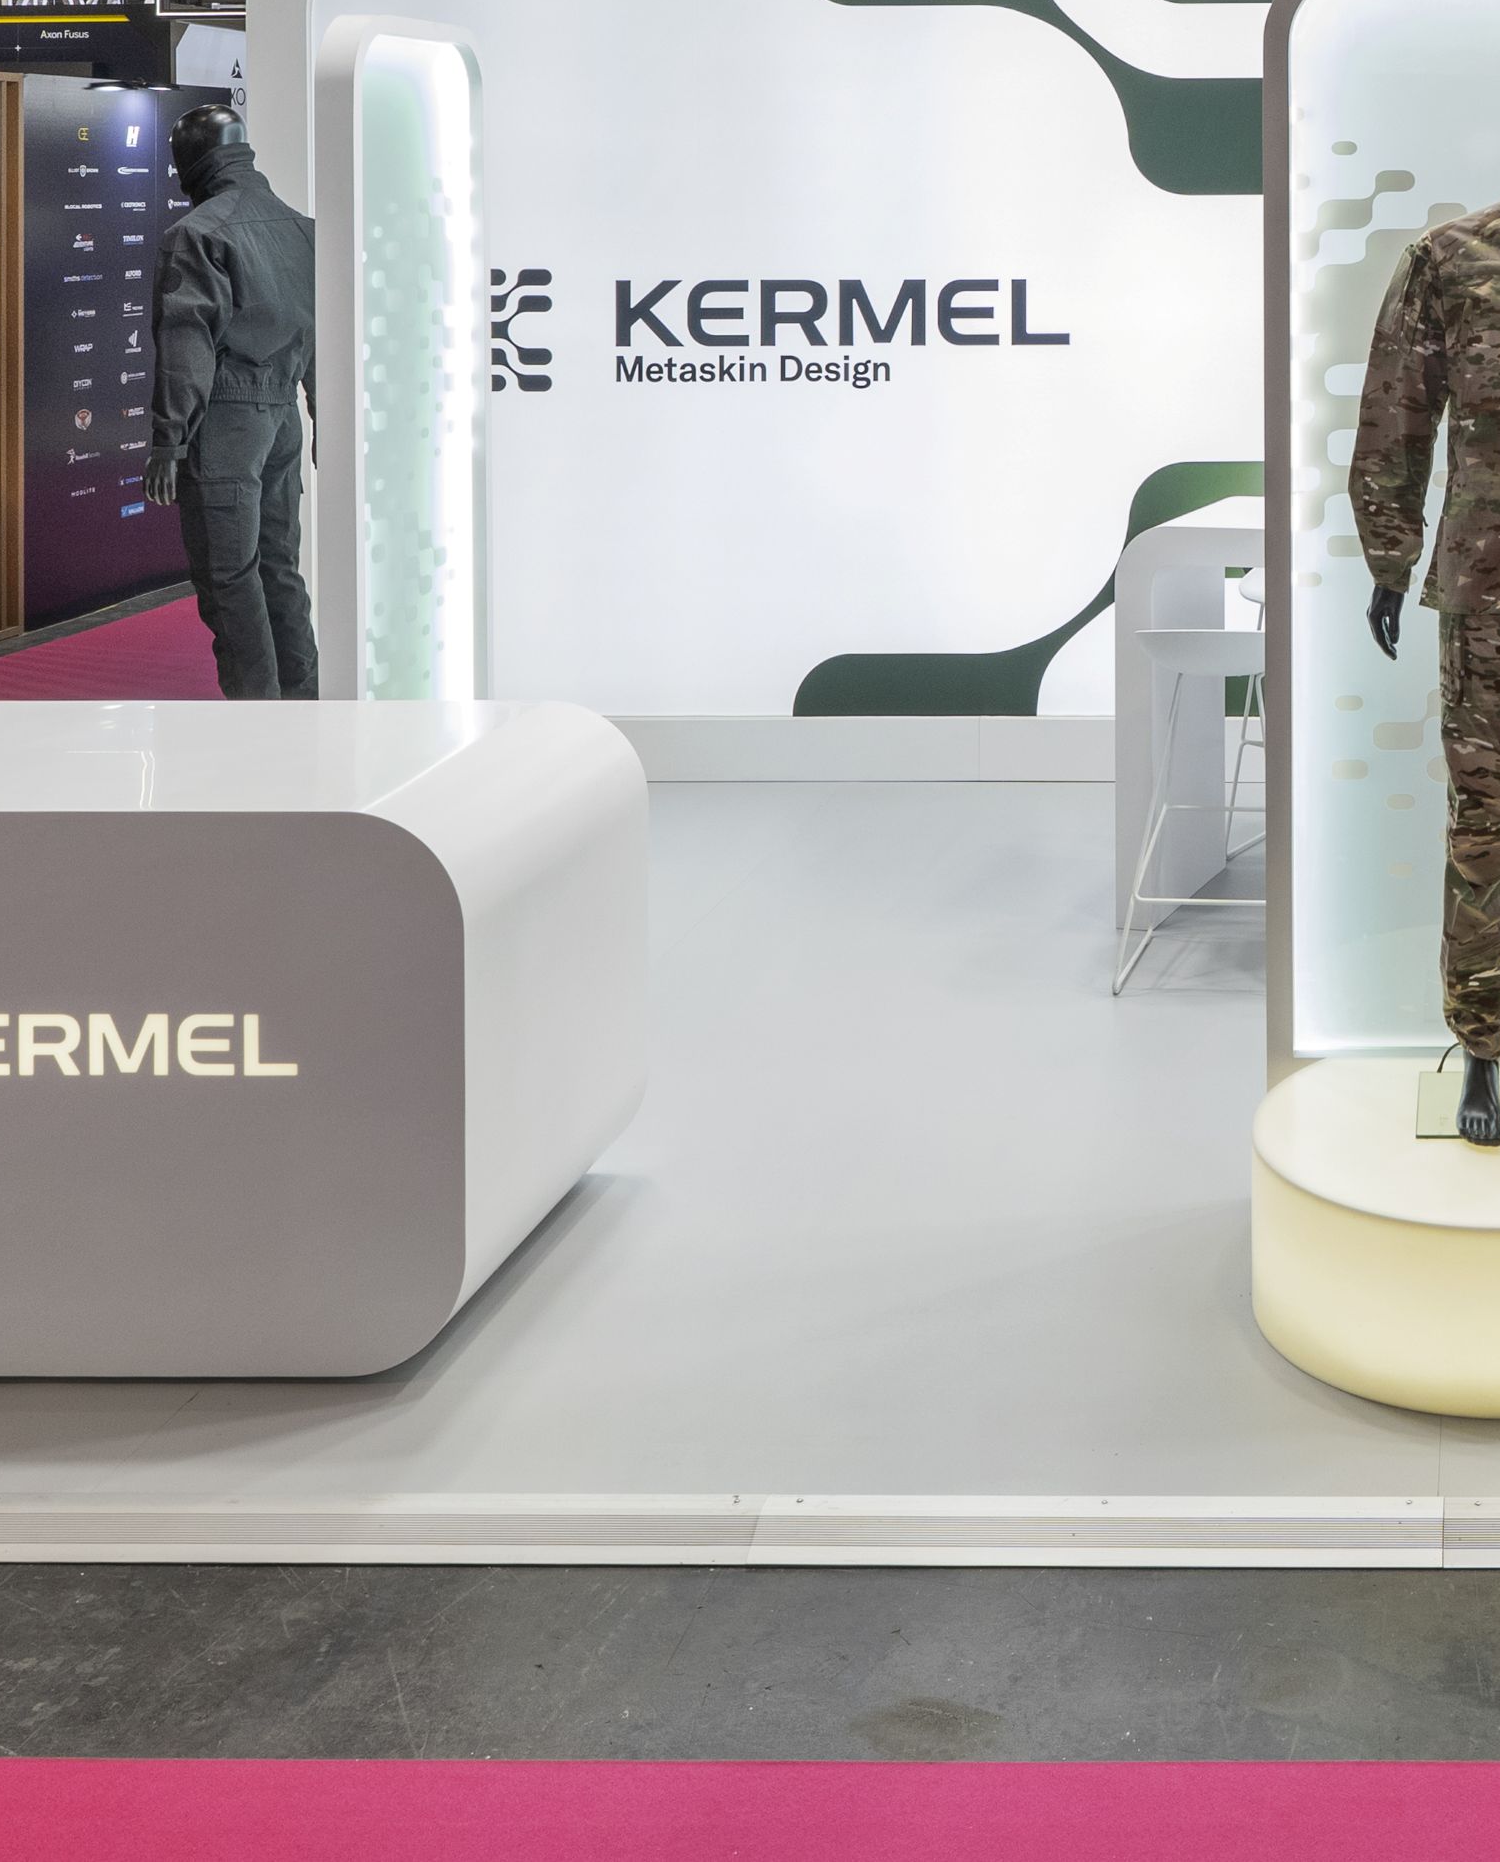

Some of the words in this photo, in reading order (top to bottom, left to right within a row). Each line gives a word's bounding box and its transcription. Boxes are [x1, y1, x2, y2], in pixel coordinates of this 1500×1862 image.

[40, 30, 62, 39] Axon
[64, 29, 90, 39] Fusus
[615, 279, 1071, 347] KERMEL
[74, 343, 93, 353] WRAP
[615, 355, 767, 383] Metaskin
[780, 355, 891, 389] Design
